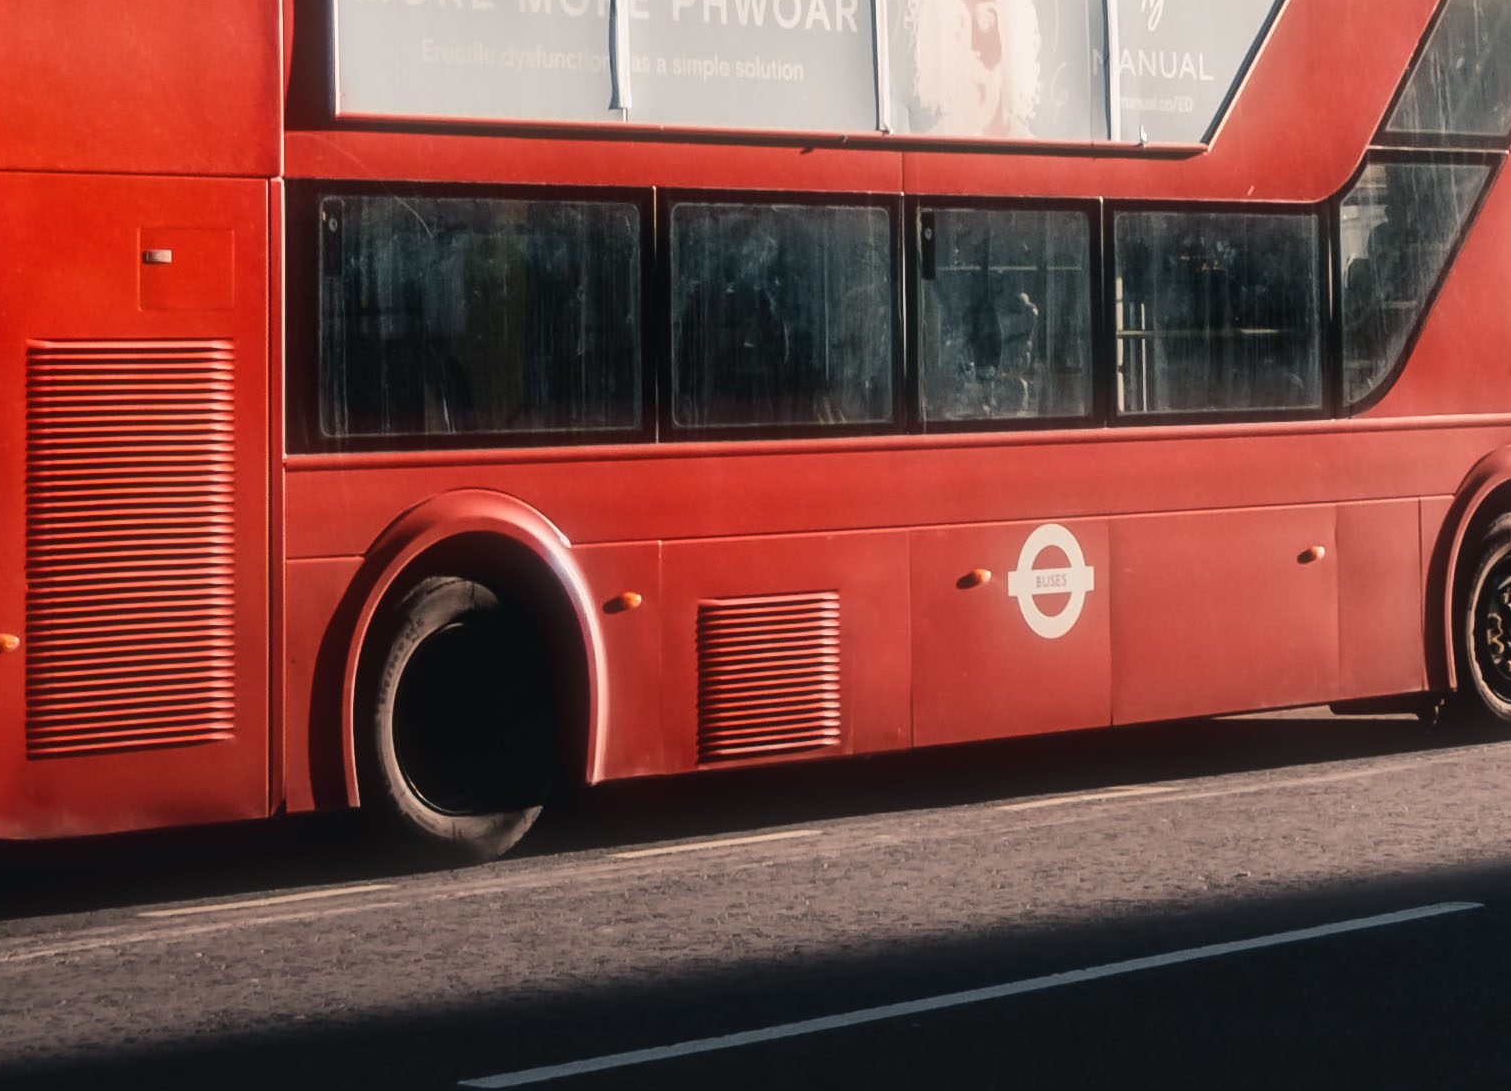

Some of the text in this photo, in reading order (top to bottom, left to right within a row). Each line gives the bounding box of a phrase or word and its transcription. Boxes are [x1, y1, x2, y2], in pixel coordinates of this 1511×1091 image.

[656, 57, 666, 73] a
[672, 53, 730, 82] simple
[735, 56, 804, 81] solution
[1035, 574, 1067, 589] BUSES
